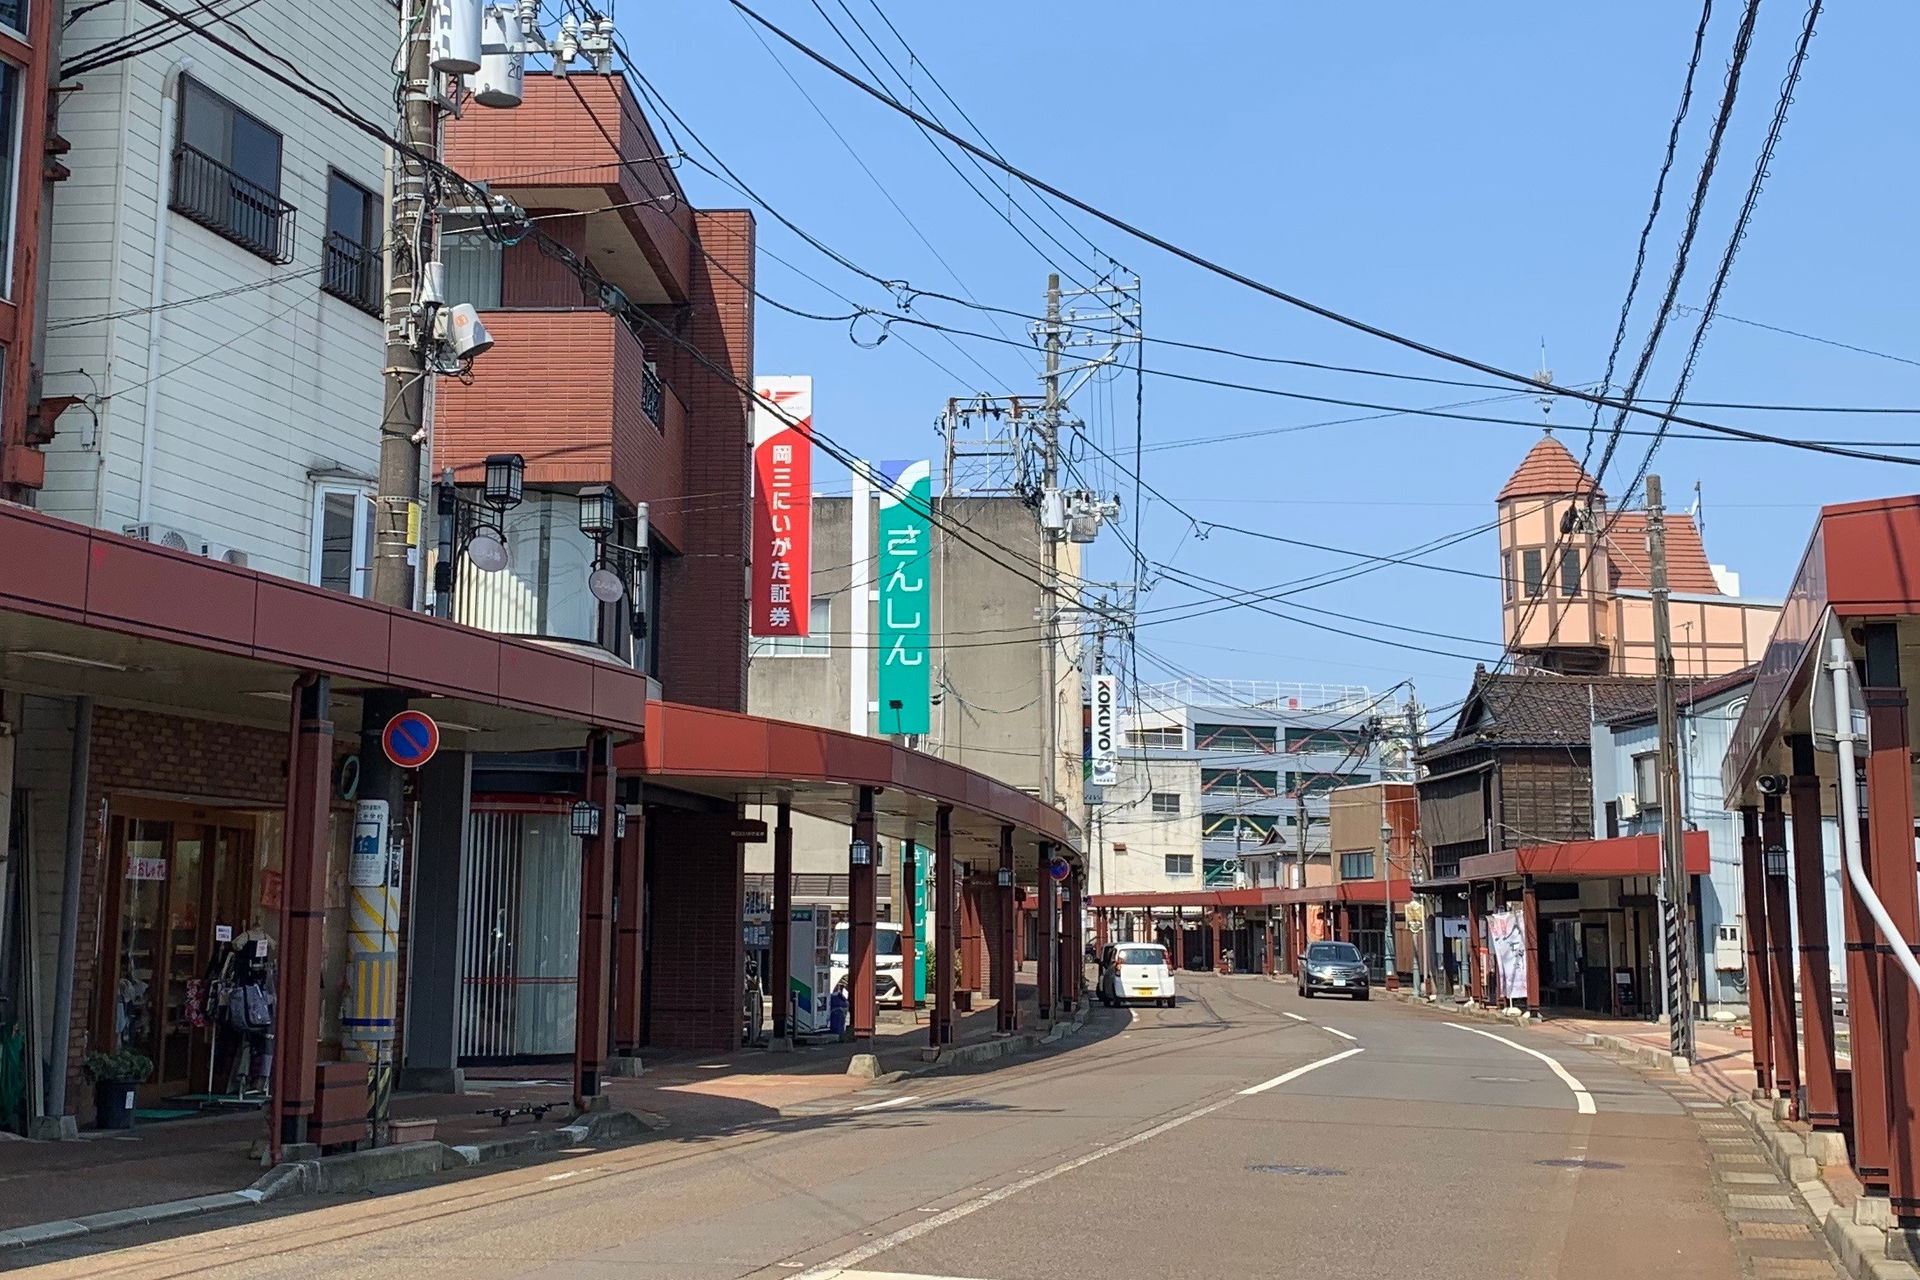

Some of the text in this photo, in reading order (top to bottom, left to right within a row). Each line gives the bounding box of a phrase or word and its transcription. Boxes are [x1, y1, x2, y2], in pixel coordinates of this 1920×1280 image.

[508, 62, 522, 80] 20
[770, 445, 792, 627] 岡三にいがた証券
[886, 525, 923, 667] さんしん
[1098, 680, 1111, 751] KOKUYO
